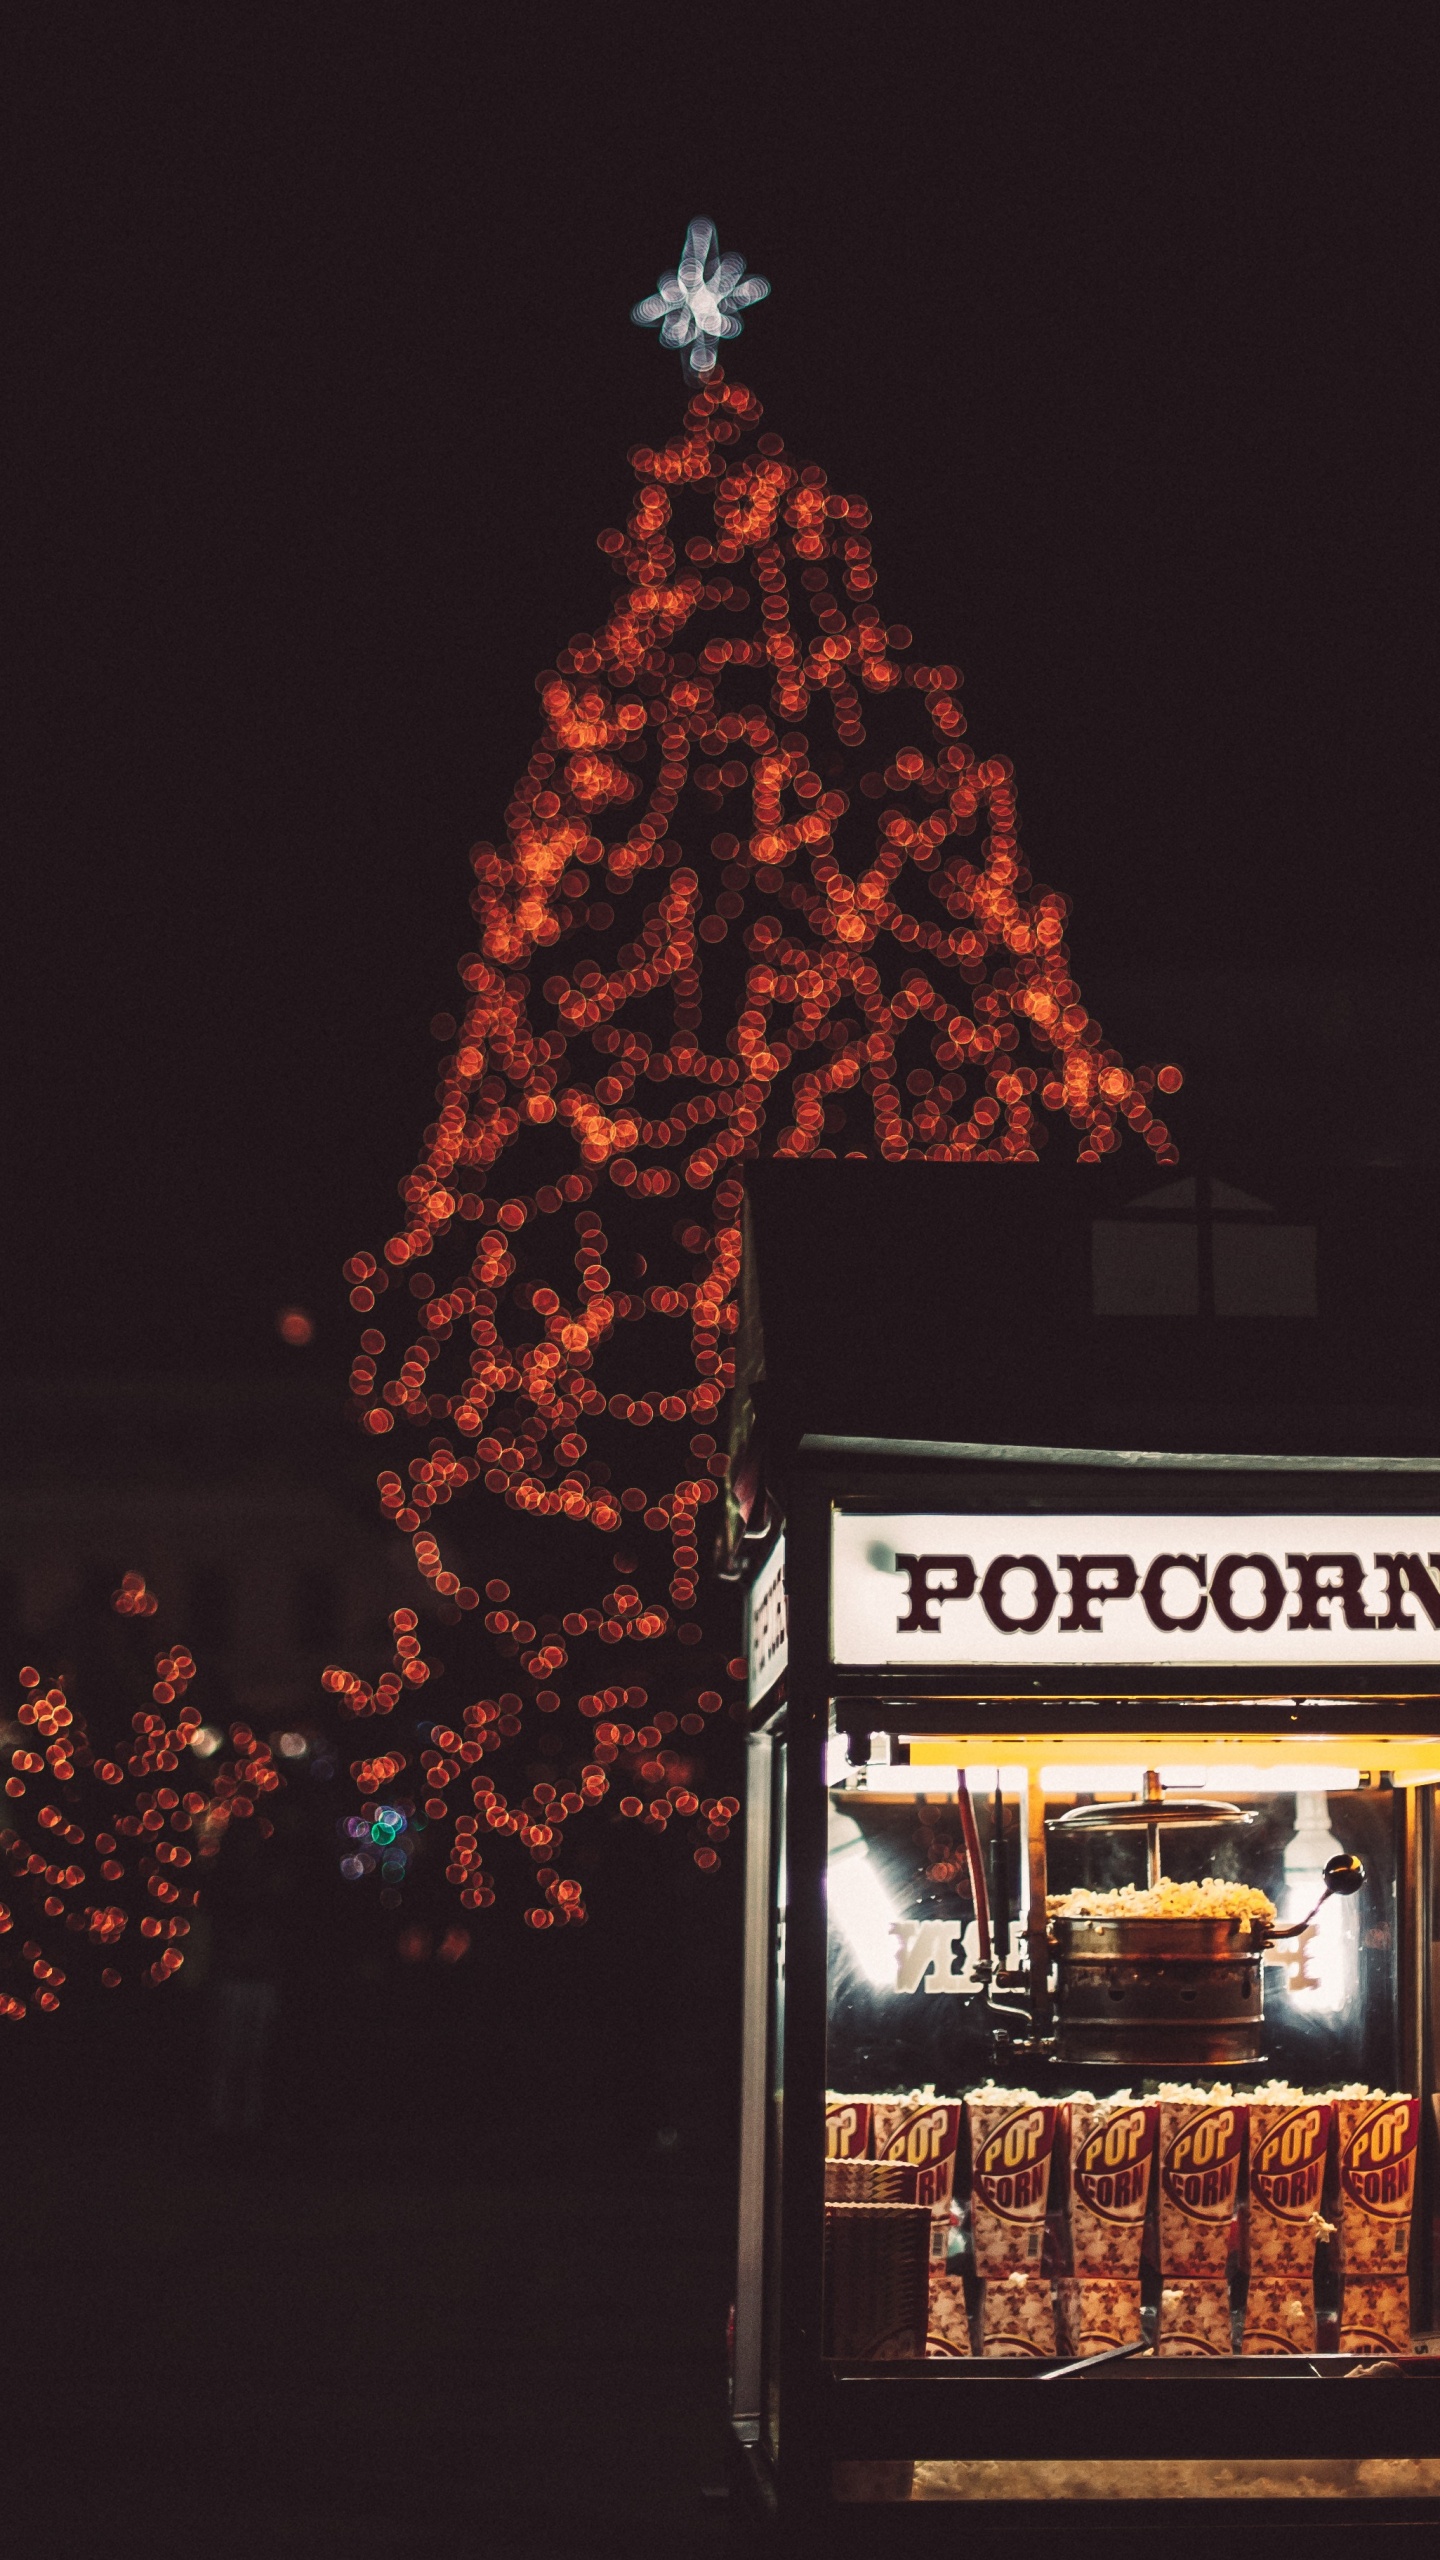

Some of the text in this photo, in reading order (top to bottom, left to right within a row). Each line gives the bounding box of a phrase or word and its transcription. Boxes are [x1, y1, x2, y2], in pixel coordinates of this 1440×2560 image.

[895, 1552, 1440, 1635] POPCORN
[826, 2108, 857, 2160] OP
[888, 2109, 948, 2165] POP
[984, 2110, 1044, 2172] POP
[1085, 2110, 1146, 2171] POP
[1173, 2110, 1234, 2170] POP
[1262, 2109, 1320, 2172] POP
[1352, 2104, 1410, 2168] POP
[984, 2163, 1044, 2209] CORN
[1084, 2163, 1144, 2208] CORN
[1172, 2162, 1233, 2207] CORN
[1261, 2162, 1319, 2207] CORN
[1352, 2158, 1409, 2204] CORN
